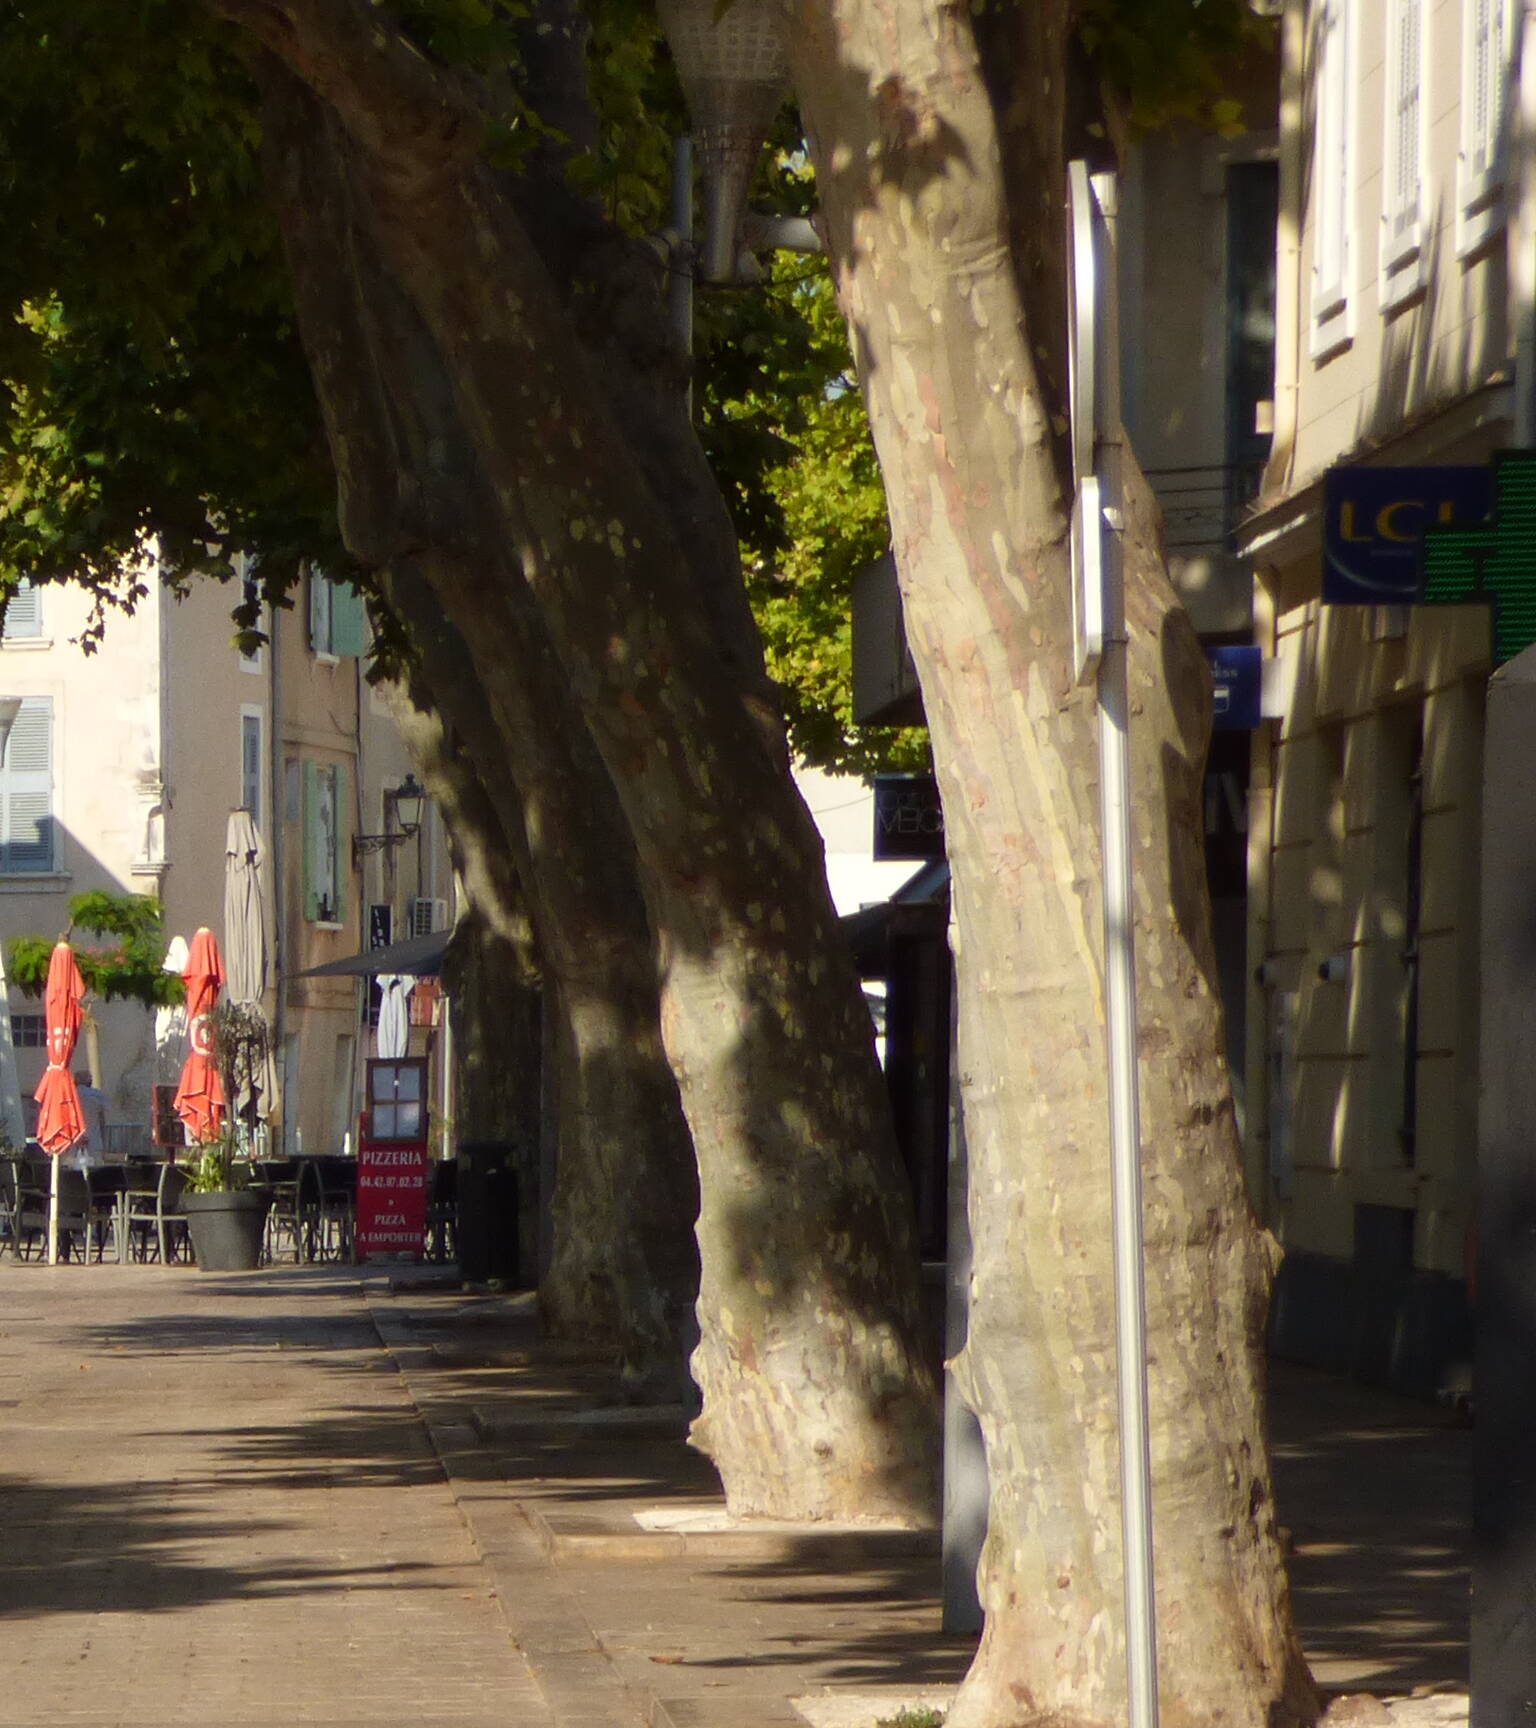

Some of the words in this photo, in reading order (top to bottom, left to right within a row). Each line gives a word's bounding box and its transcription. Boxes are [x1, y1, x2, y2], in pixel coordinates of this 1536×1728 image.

[362, 1151, 422, 1166] PIZZERIA
[374, 1213, 407, 1226] PIZZA
[368, 1231, 423, 1244] EMPORTER
